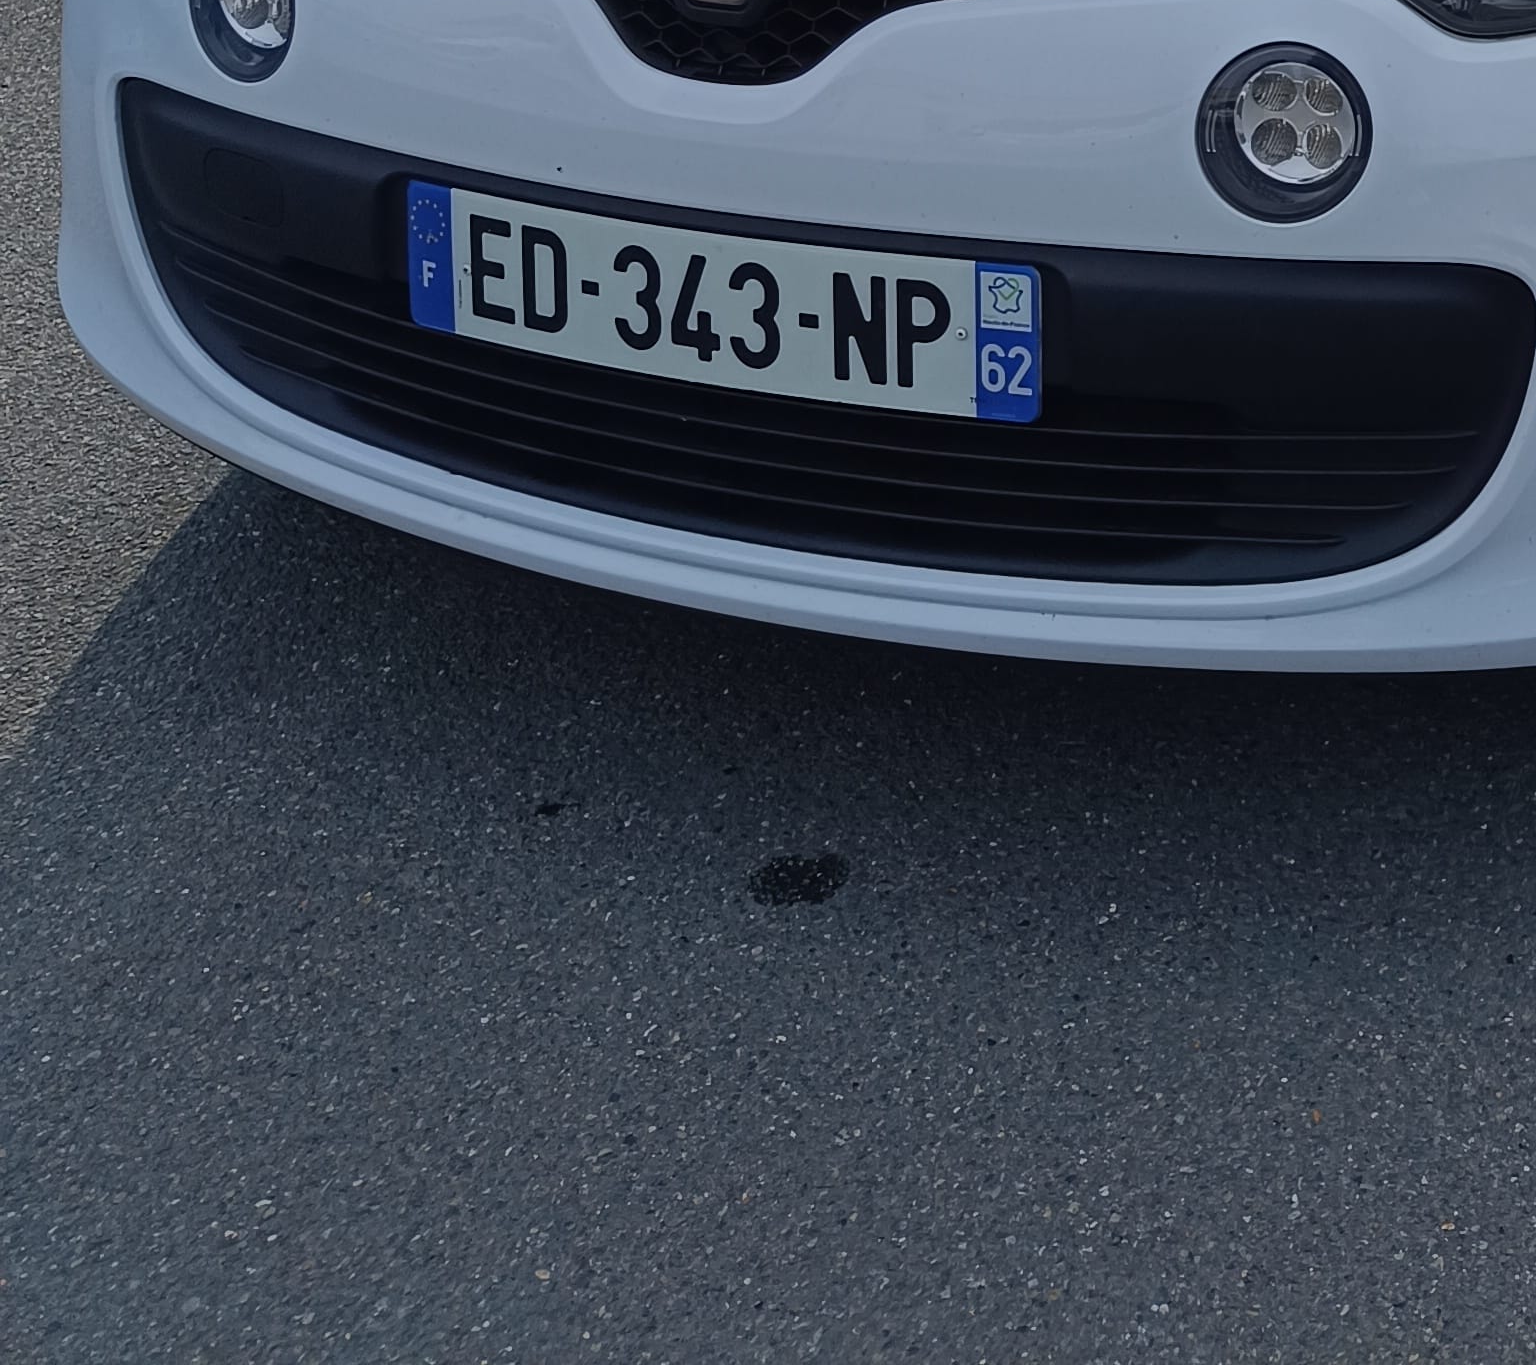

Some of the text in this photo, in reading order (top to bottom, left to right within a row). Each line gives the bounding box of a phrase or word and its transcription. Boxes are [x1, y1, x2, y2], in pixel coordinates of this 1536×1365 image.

[422, 260, 437, 288] F
[469, 213, 952, 388] ED-343-NP
[981, 343, 1033, 396] 62
